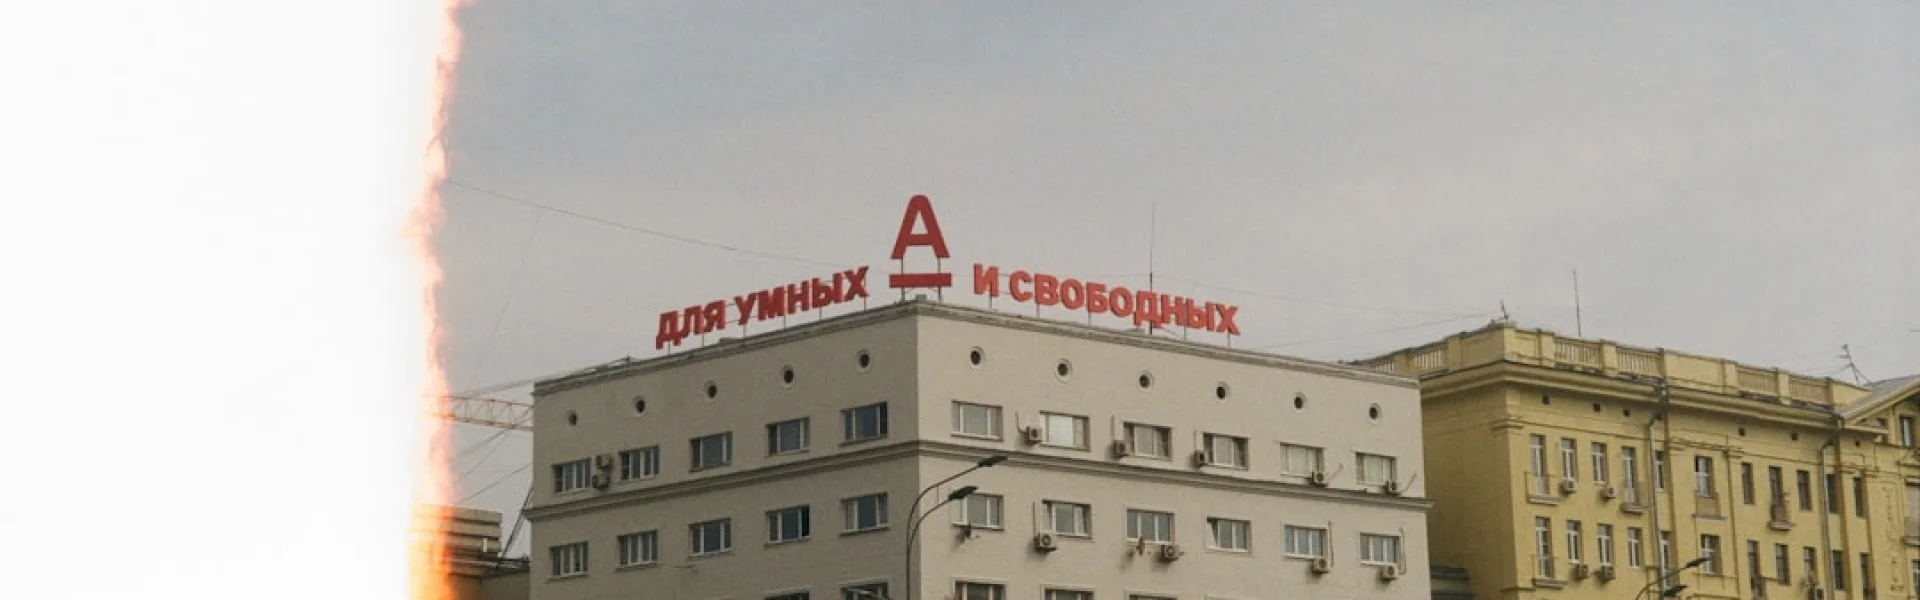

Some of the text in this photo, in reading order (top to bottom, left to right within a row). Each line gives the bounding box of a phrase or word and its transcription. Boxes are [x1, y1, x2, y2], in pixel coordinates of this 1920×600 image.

[655, 265, 869, 350] ДЛЯ УМНЫХ
[973, 262, 1241, 336] И СВОБОДНЫХ
